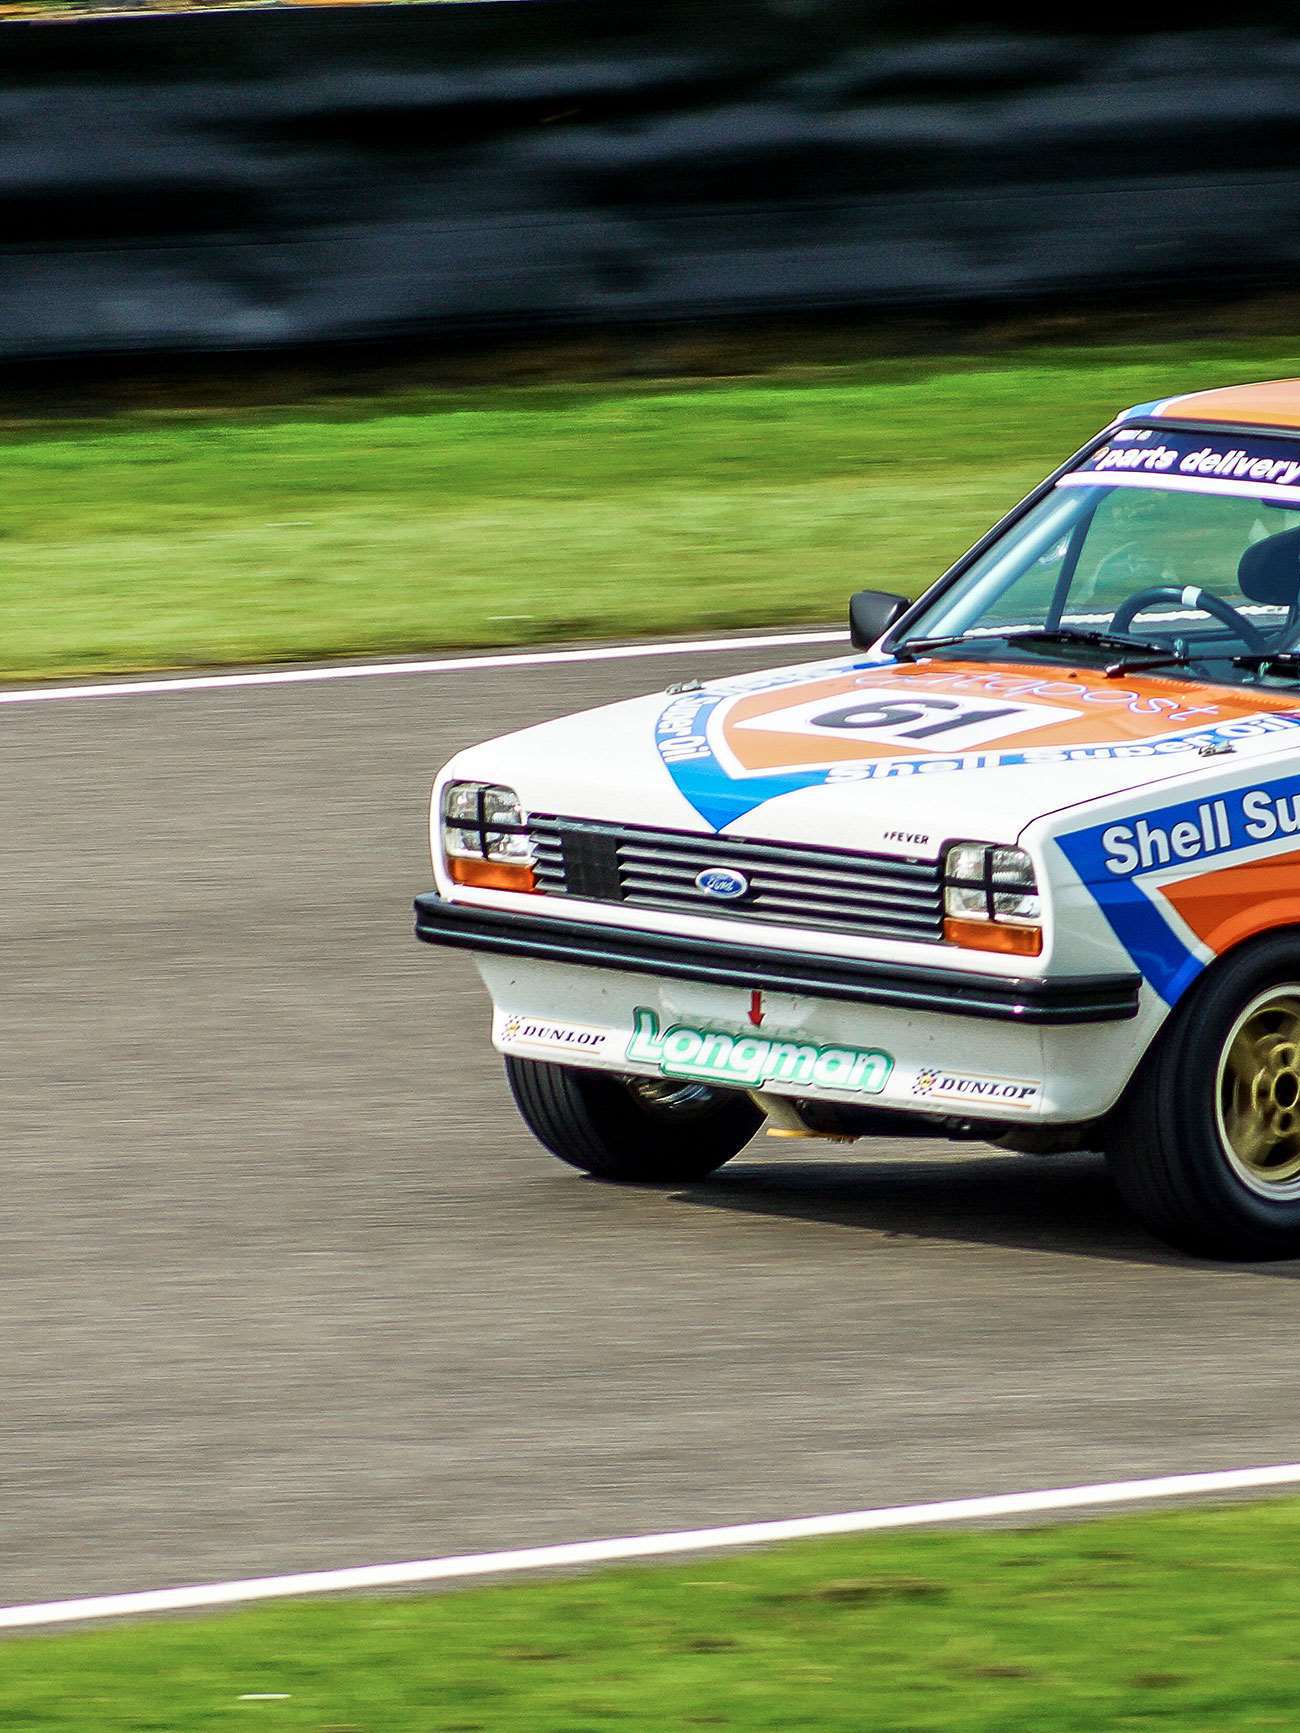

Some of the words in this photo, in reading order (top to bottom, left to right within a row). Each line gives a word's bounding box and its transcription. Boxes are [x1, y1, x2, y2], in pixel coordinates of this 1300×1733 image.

[1094, 446, 1179, 471] parts
[808, 698, 1025, 740] 61
[657, 735, 712, 763] Oil
[824, 753, 1001, 784] Shell
[1223, 712, 1298, 743] Oil
[1101, 799, 1230, 875] Shell
[523, 1024, 606, 1046] DUNLOP
[627, 1007, 894, 1093] Longman
[939, 1077, 1037, 1099] DUNLOP
